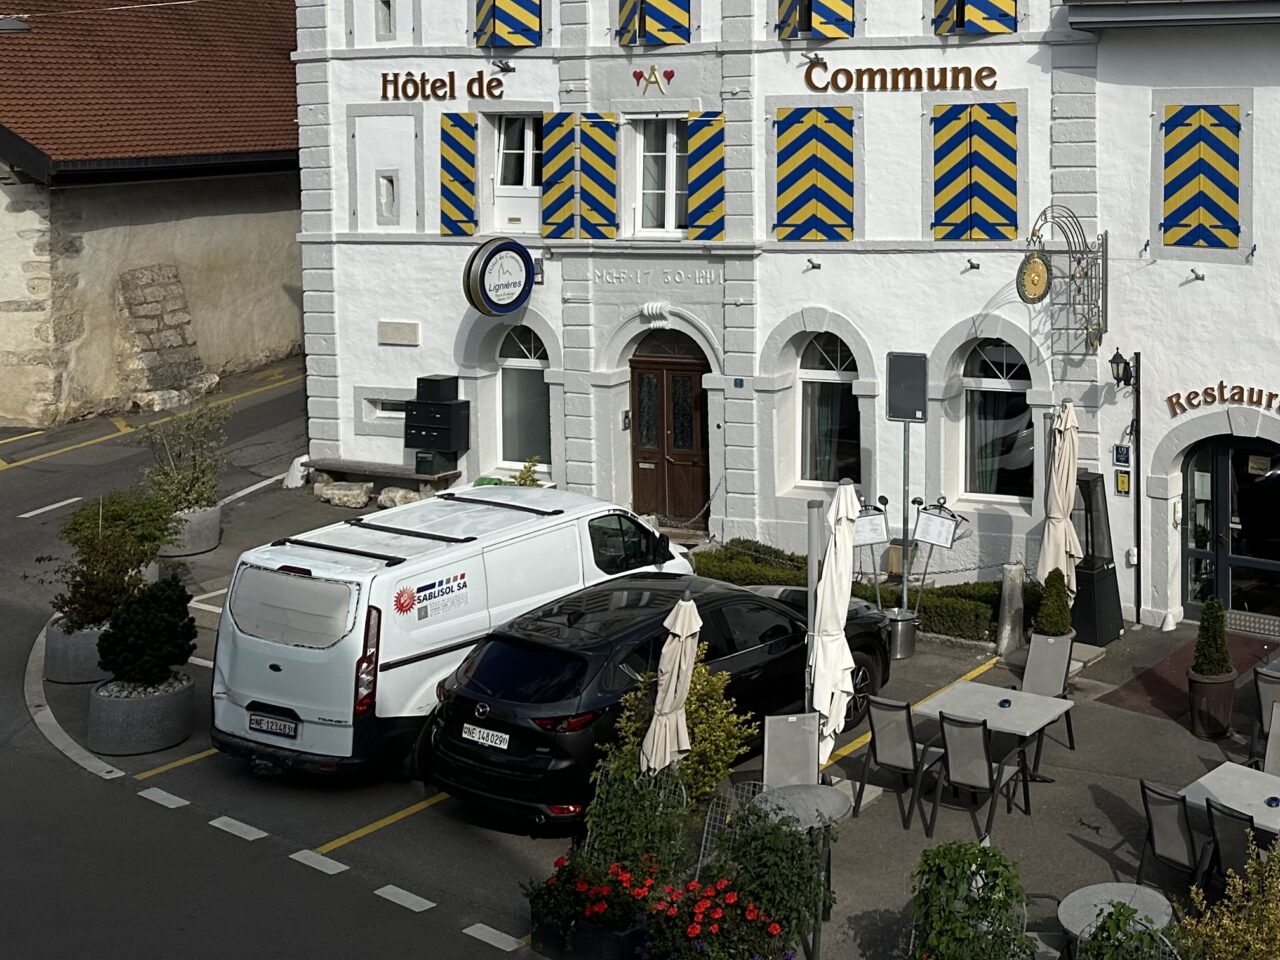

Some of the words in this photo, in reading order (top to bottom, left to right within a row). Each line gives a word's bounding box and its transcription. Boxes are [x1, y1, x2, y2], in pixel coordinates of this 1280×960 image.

[380, 70, 457, 101] Hôtel
[466, 70, 504, 100] de
[804, 61, 998, 93] Commune
[416, 585, 455, 604] SABLISOL
[456, 580, 468, 591] SA
[467, 726, 477, 738] NE
